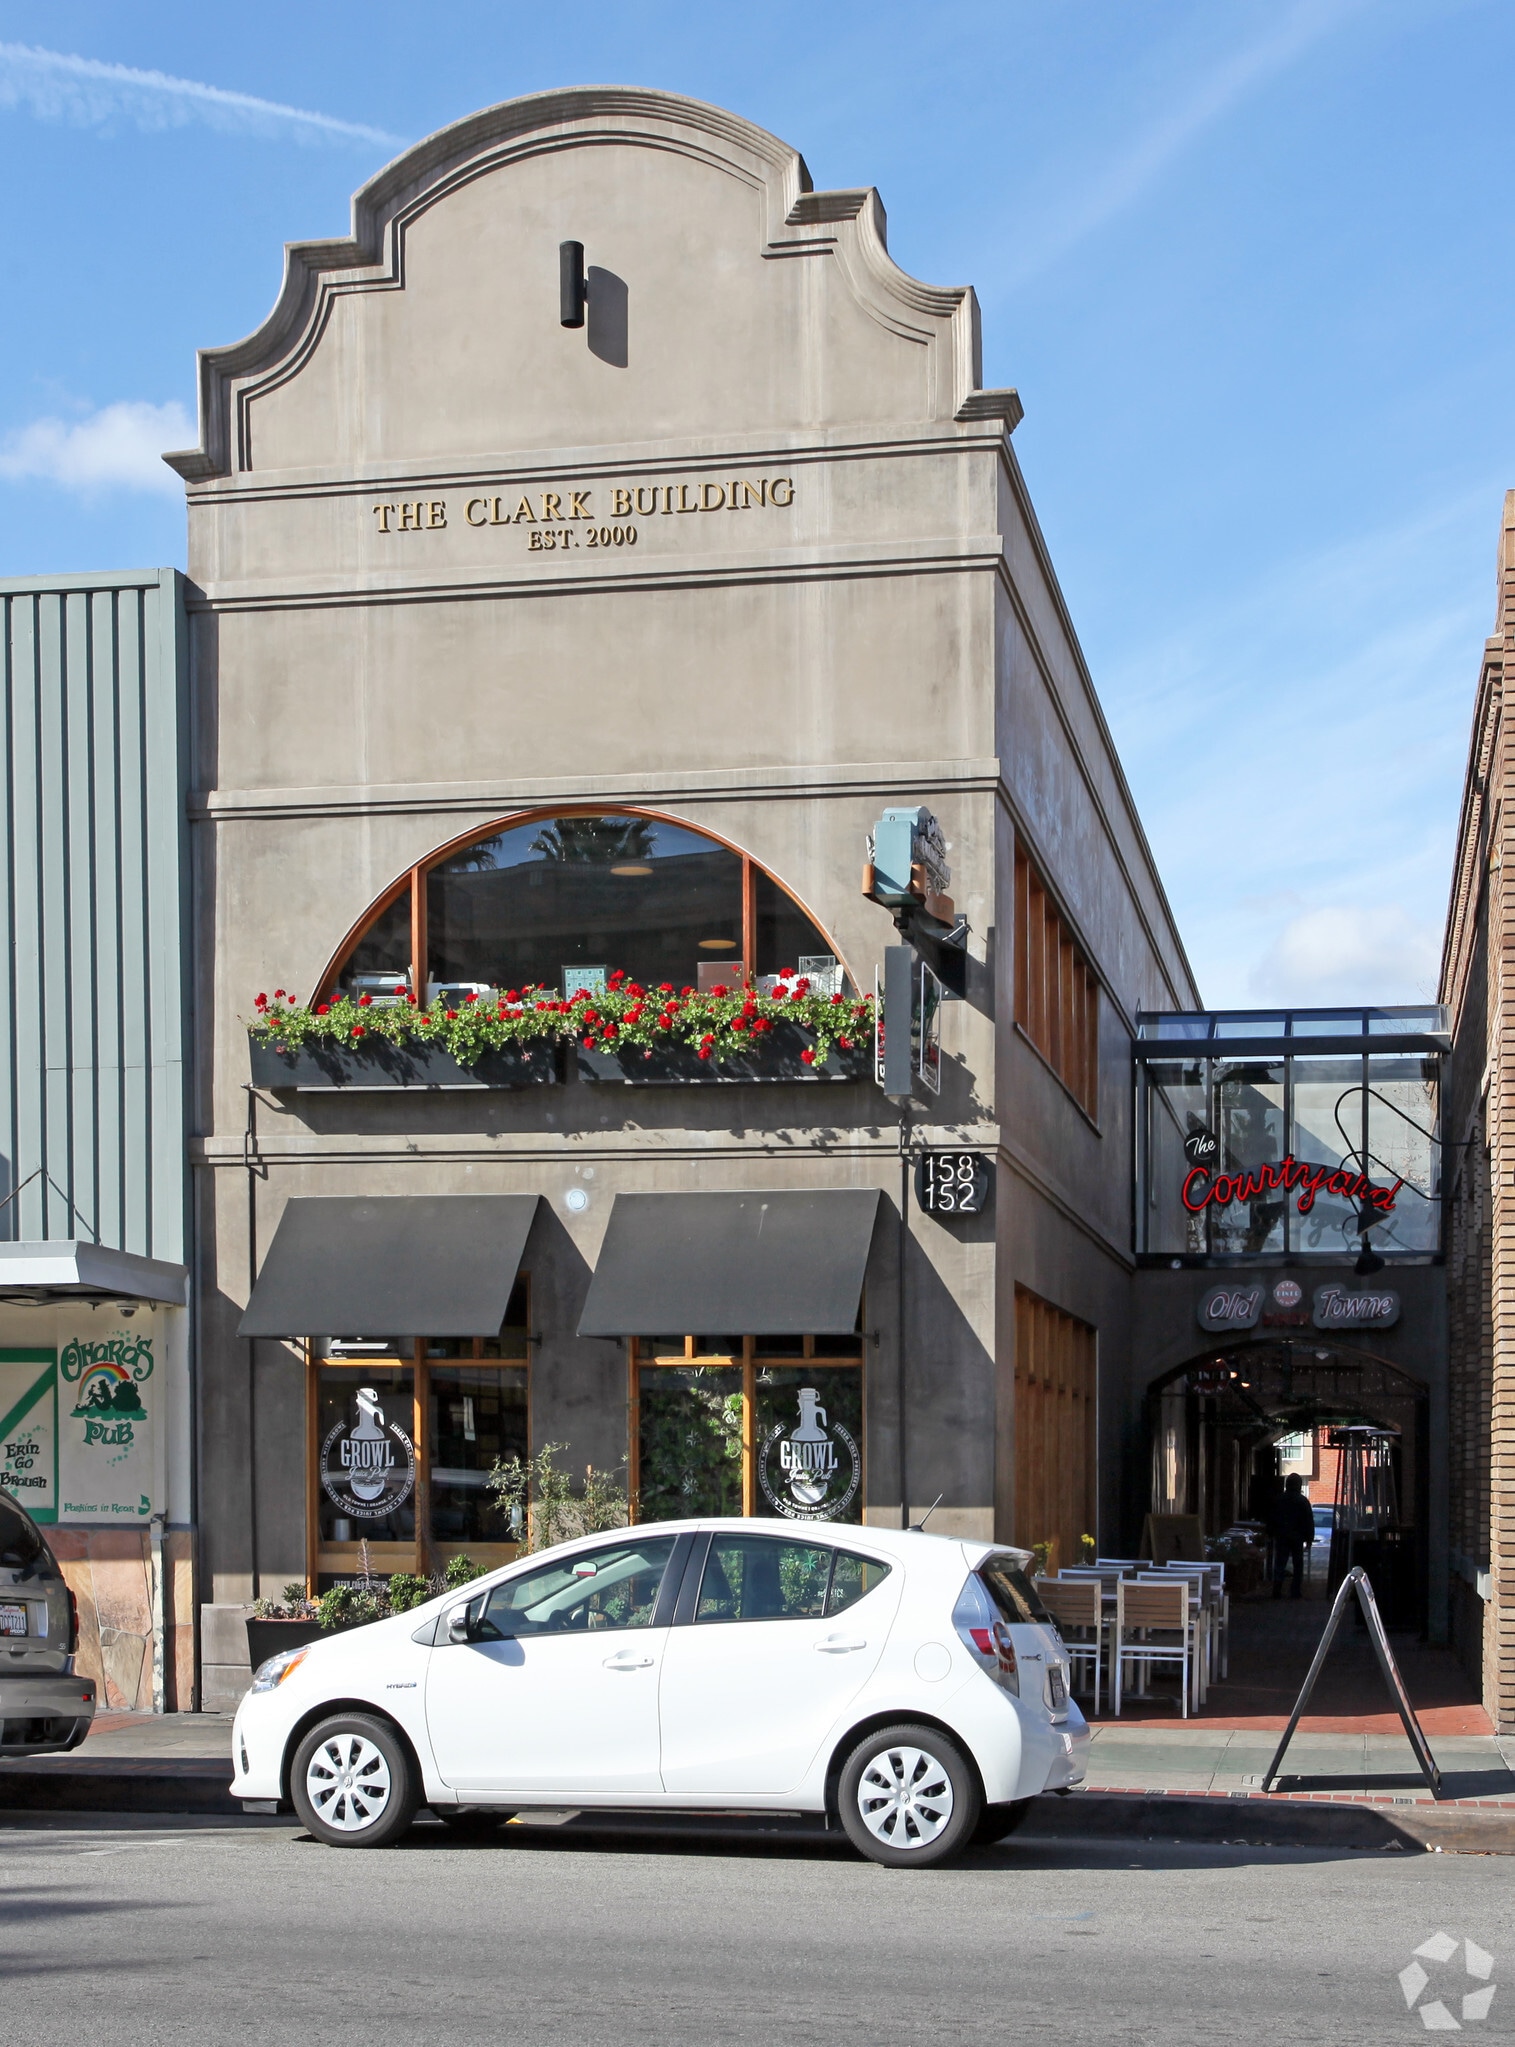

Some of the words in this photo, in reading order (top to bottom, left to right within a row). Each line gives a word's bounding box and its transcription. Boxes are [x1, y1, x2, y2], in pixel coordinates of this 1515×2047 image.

[373, 499, 447, 533] THE
[463, 490, 595, 528] CLARK
[609, 478, 796, 518] BUILDING
[527, 529, 579, 551] EST.
[586, 524, 638, 549] 2000
[1186, 1134, 1216, 1154] The
[925, 1155, 974, 1182] 158
[1181, 1154, 1404, 1212] Courtyard
[925, 1182, 977, 1211] 152
[1206, 1290, 1259, 1320] Old
[1320, 1289, 1394, 1319] Towne
[341, 1439, 394, 1467] GROWL
[780, 1441, 838, 1470] GROWL
